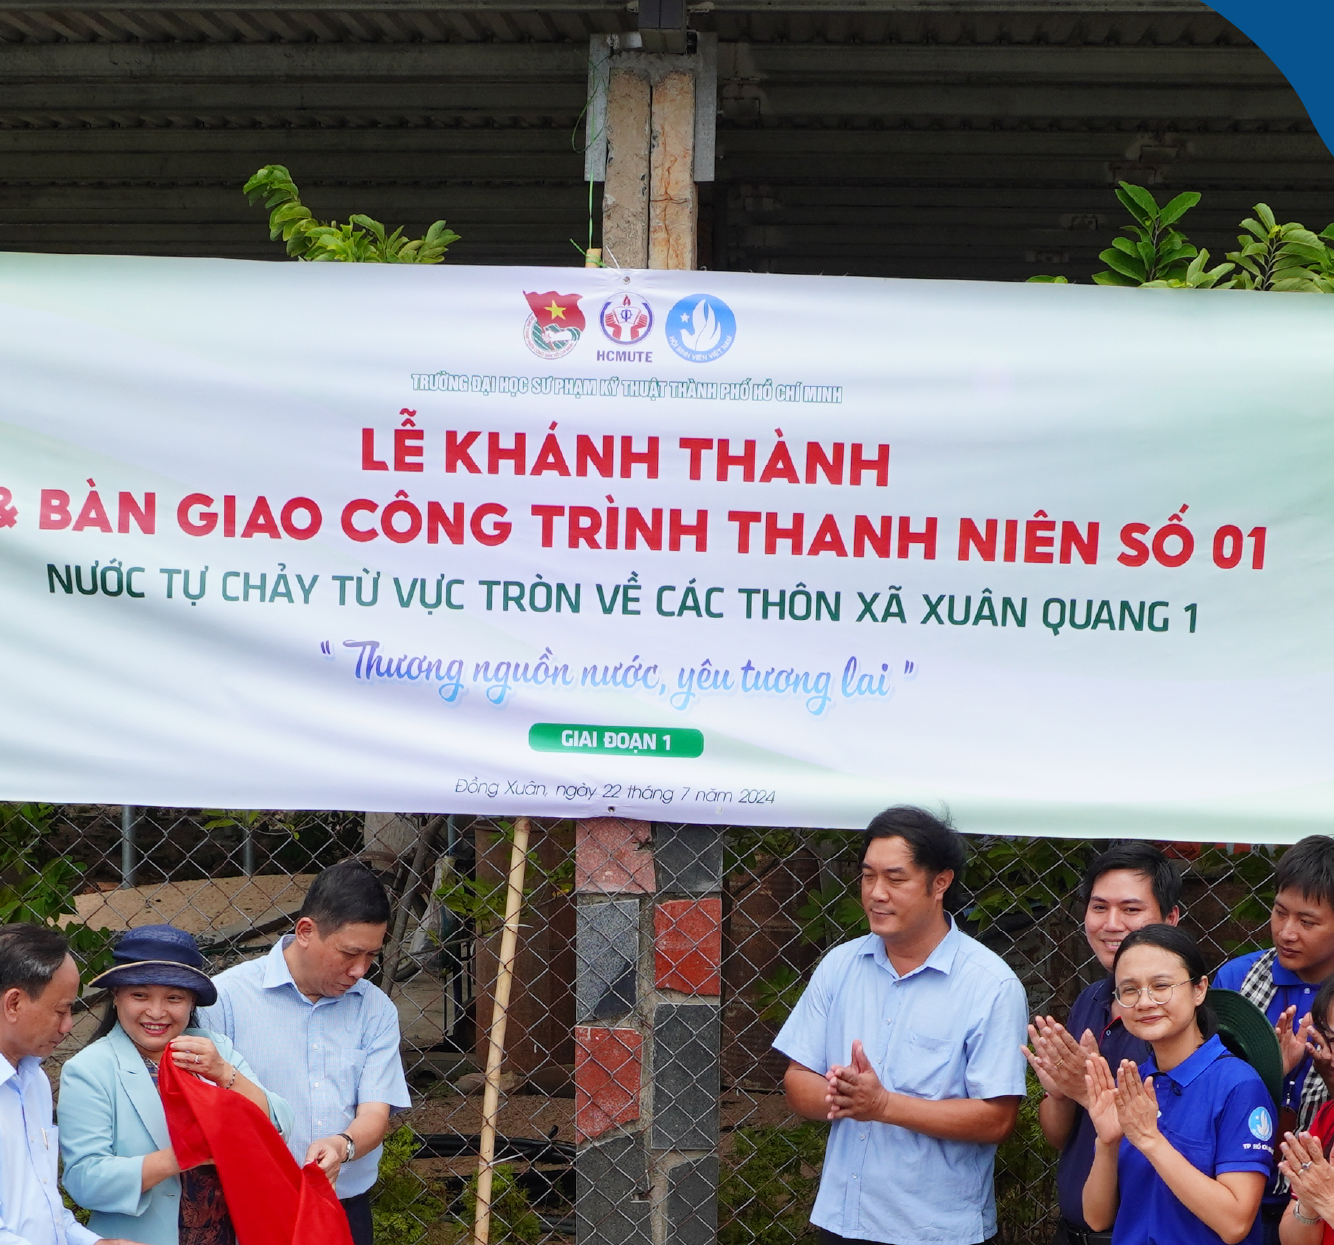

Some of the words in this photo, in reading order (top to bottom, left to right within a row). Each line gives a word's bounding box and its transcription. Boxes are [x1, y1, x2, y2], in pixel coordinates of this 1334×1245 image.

[596, 350, 653, 363] HCMUTE
[411, 370, 469, 392] TRƯỜNG
[471, 376, 496, 396] ĐẠI
[499, 377, 528, 397] HỌC
[531, 376, 553, 395] SƯ
[554, 378, 597, 399] PHẠM
[600, 376, 620, 397] KỸ
[621, 377, 667, 401] THUẬT
[669, 378, 717, 400] THÀNH
[720, 378, 751, 401] PHỐ
[752, 378, 773, 401] HỒ
[775, 381, 802, 402] CHÍ
[803, 385, 843, 403] MINH
[361, 408, 424, 473] LỄ
[445, 421, 659, 479] KHÁNH
[680, 427, 890, 487] THÀNH
[39, 478, 156, 535] BÀN
[177, 493, 323, 541] GIAO
[341, 489, 512, 547] CÔNG
[531, 494, 708, 553] TRÌNH
[728, 511, 937, 560] THANH
[958, 509, 1099, 565] NIÊN
[1116, 504, 1194, 569] SỐ
[1212, 524, 1267, 571] 01
[47, 558, 145, 599] NƯỚC
[159, 564, 207, 607] TỰ
[221, 563, 319, 604] CHẢY
[331, 566, 379, 608] TỪ
[392, 575, 464, 617] VỰC
[478, 577, 581, 615] TRÒN
[596, 570, 641, 617] VỀ
[656, 577, 724, 620] CÁC
[738, 582, 841, 622] THÔN
[856, 586, 907, 625] XÃ
[920, 587, 1027, 629] XUÂN
[1043, 598, 1169, 636] QUANG
[1183, 602, 1199, 634] 1
[343, 639, 464, 703] Thương
[472, 647, 574, 705] nguồn
[581, 654, 666, 695] nước,
[670, 658, 735, 711] yêu
[841, 656, 890, 697] lai
[561, 729, 597, 748] GIAI
[604, 731, 656, 754] ĐOẠN
[662, 734, 672, 750] 1
[455, 777, 499, 798] Đồng
[504, 779, 548, 797] Xuân,
[555, 783, 597, 800] ngày
[602, 784, 621, 798] 22
[627, 784, 674, 804] tháng
[681, 787, 690, 800] 7
[696, 787, 733, 803] năm
[738, 789, 776, 804] 2024
